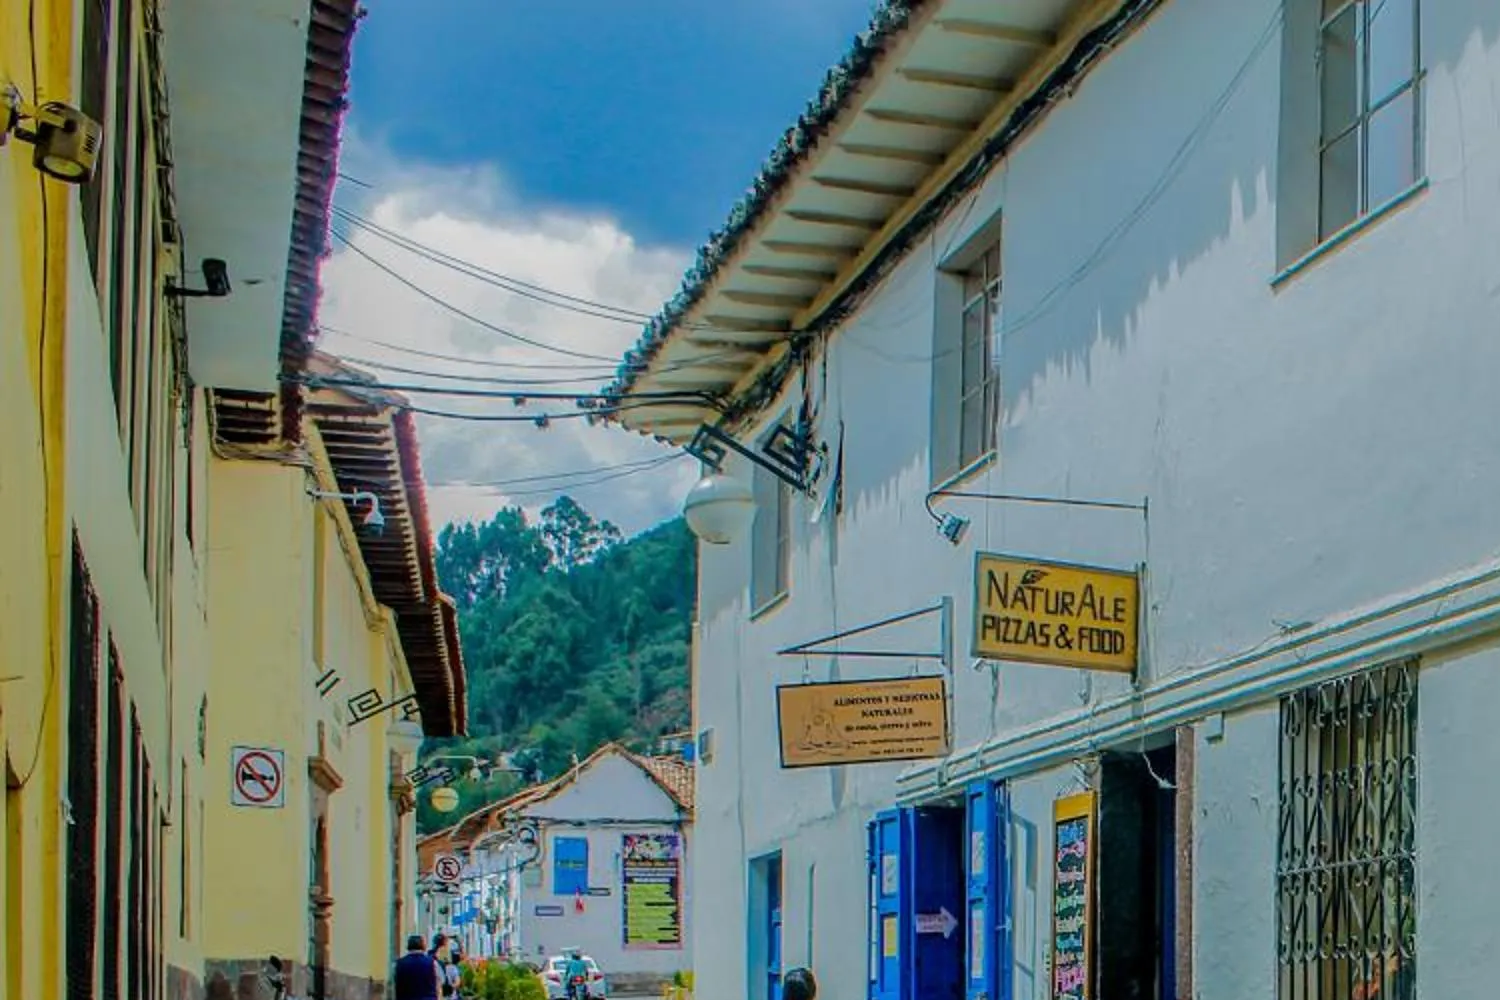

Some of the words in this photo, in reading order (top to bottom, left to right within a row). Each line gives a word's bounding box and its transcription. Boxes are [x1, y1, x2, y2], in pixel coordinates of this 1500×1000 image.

[981, 613, 1050, 648] PIZZAS
[1054, 623, 1073, 650] &
[1077, 626, 1125, 654] FOOD
